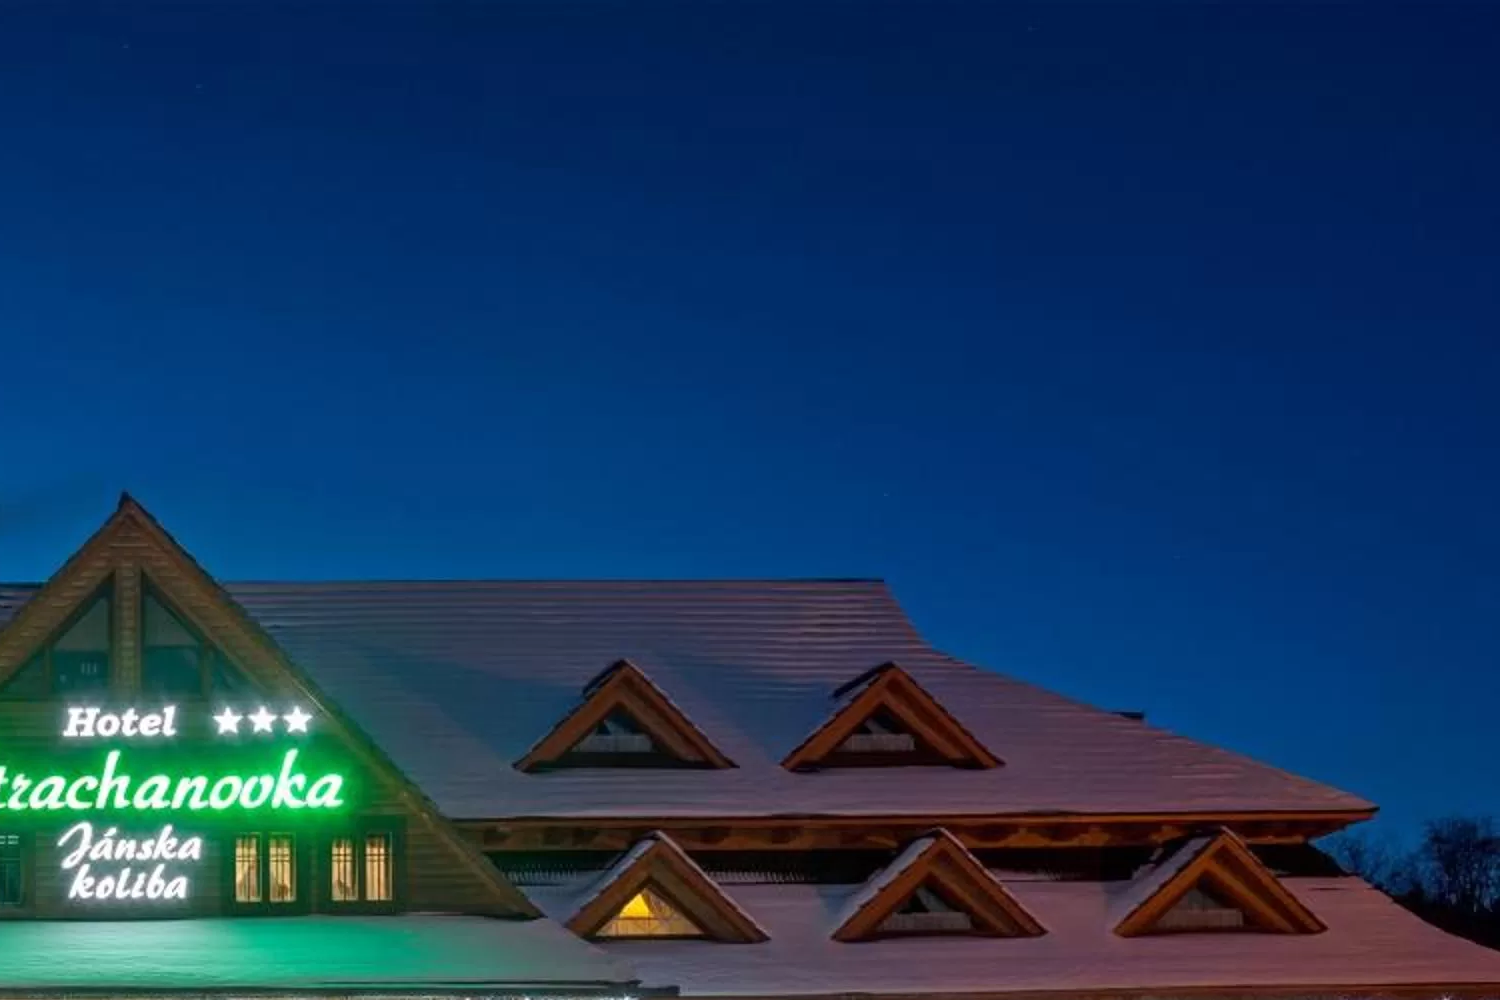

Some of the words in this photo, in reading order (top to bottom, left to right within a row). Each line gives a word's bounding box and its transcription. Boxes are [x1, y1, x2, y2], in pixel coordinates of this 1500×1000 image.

[62, 706, 177, 737] Hotel
[56, 820, 202, 869] Jánska
[67, 863, 189, 899] koliba
